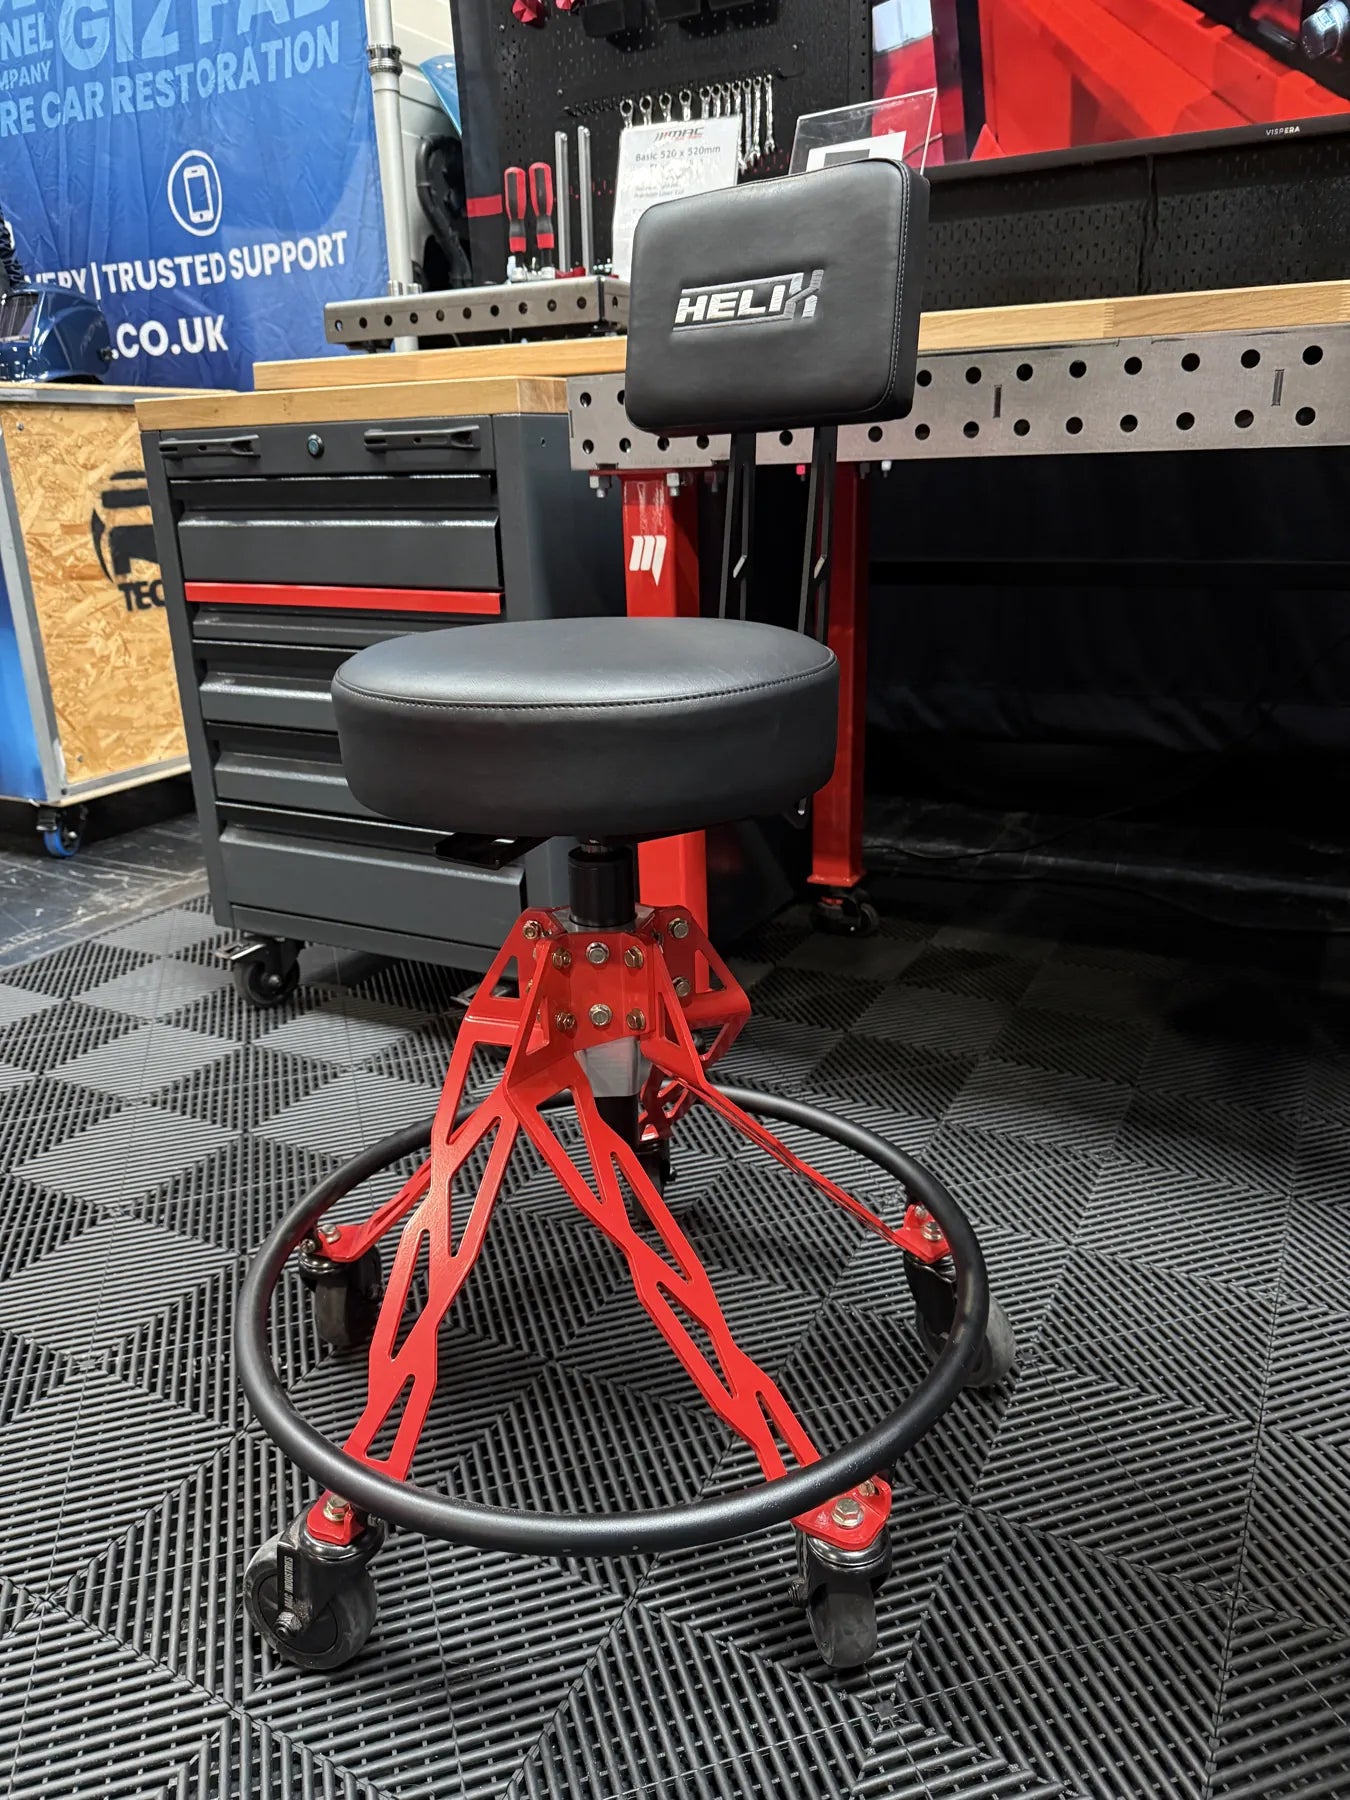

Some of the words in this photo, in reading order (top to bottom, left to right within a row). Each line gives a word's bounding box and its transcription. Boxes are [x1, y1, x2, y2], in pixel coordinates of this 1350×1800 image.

[41, 81, 104, 128] CAR
[111, 20, 339, 115] RESTORATION
[635, 152, 656, 162] Basic
[660, 150, 677, 159] 520
[688, 145, 721, 156] 520mm
[1265, 126, 1300, 136] VISPERA
[102, 252, 226, 293] TRUSTED
[229, 230, 347, 280] SUPPORT
[674, 270, 824, 326] HELIX
[112, 314, 229, 360] .CO.UK
